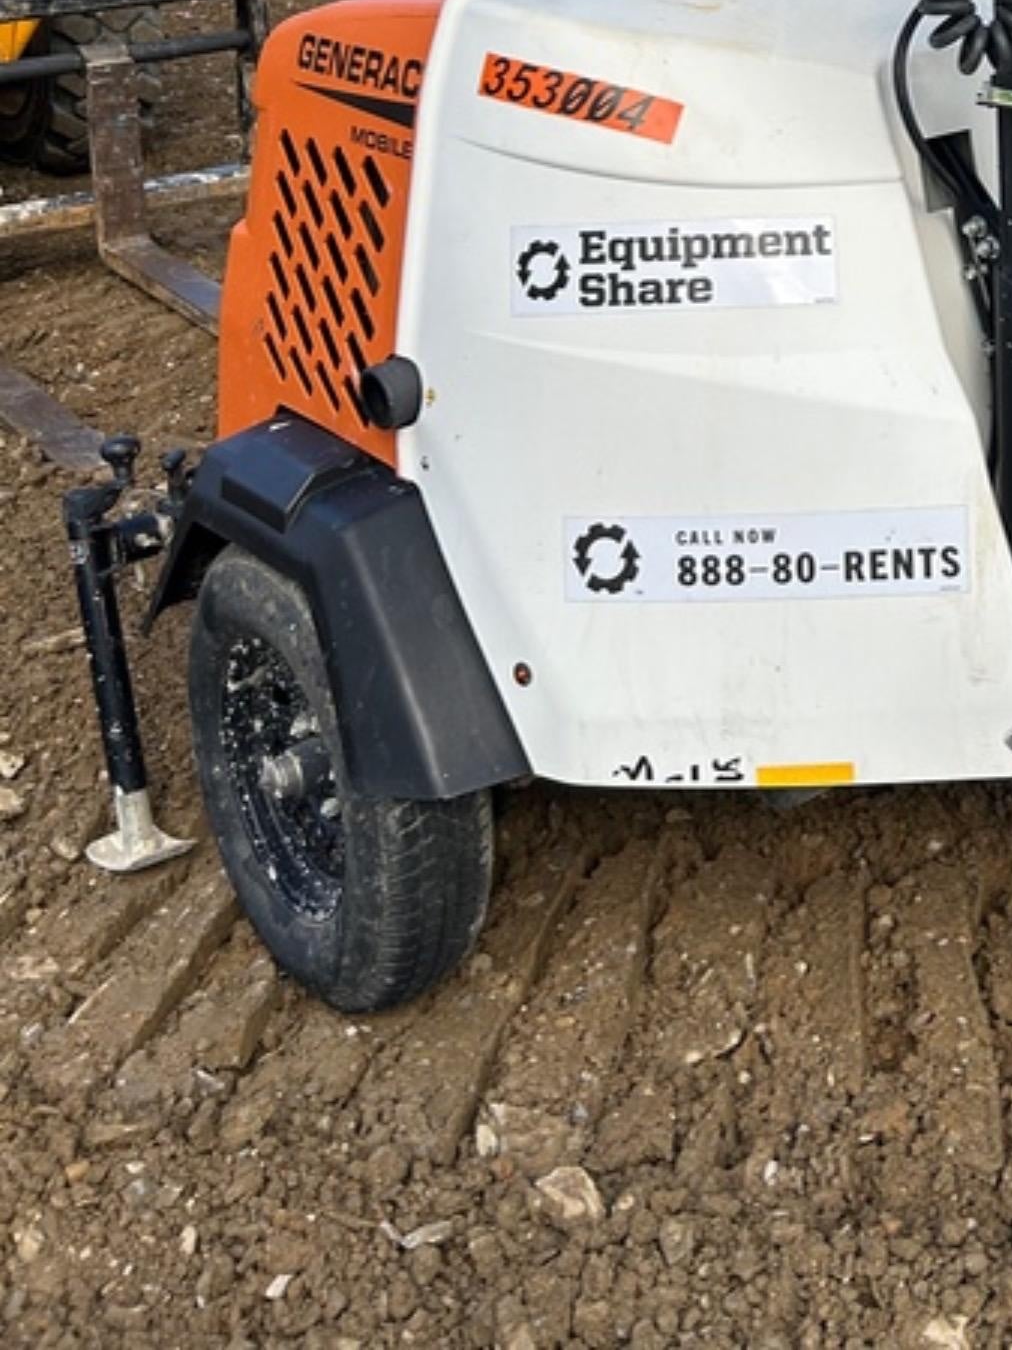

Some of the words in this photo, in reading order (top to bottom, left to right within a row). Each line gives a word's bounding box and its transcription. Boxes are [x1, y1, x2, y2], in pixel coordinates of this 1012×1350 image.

[298, 33, 423, 98] GENERAC
[482, 57, 654, 131] 353004
[350, 125, 413, 160] MOBILE
[578, 224, 832, 271] Equipment
[578, 272, 713, 307] Share
[675, 530, 723, 547] CALL
[732, 528, 777, 545] NOW
[676, 545, 962, 587] 888-80-RENTS
